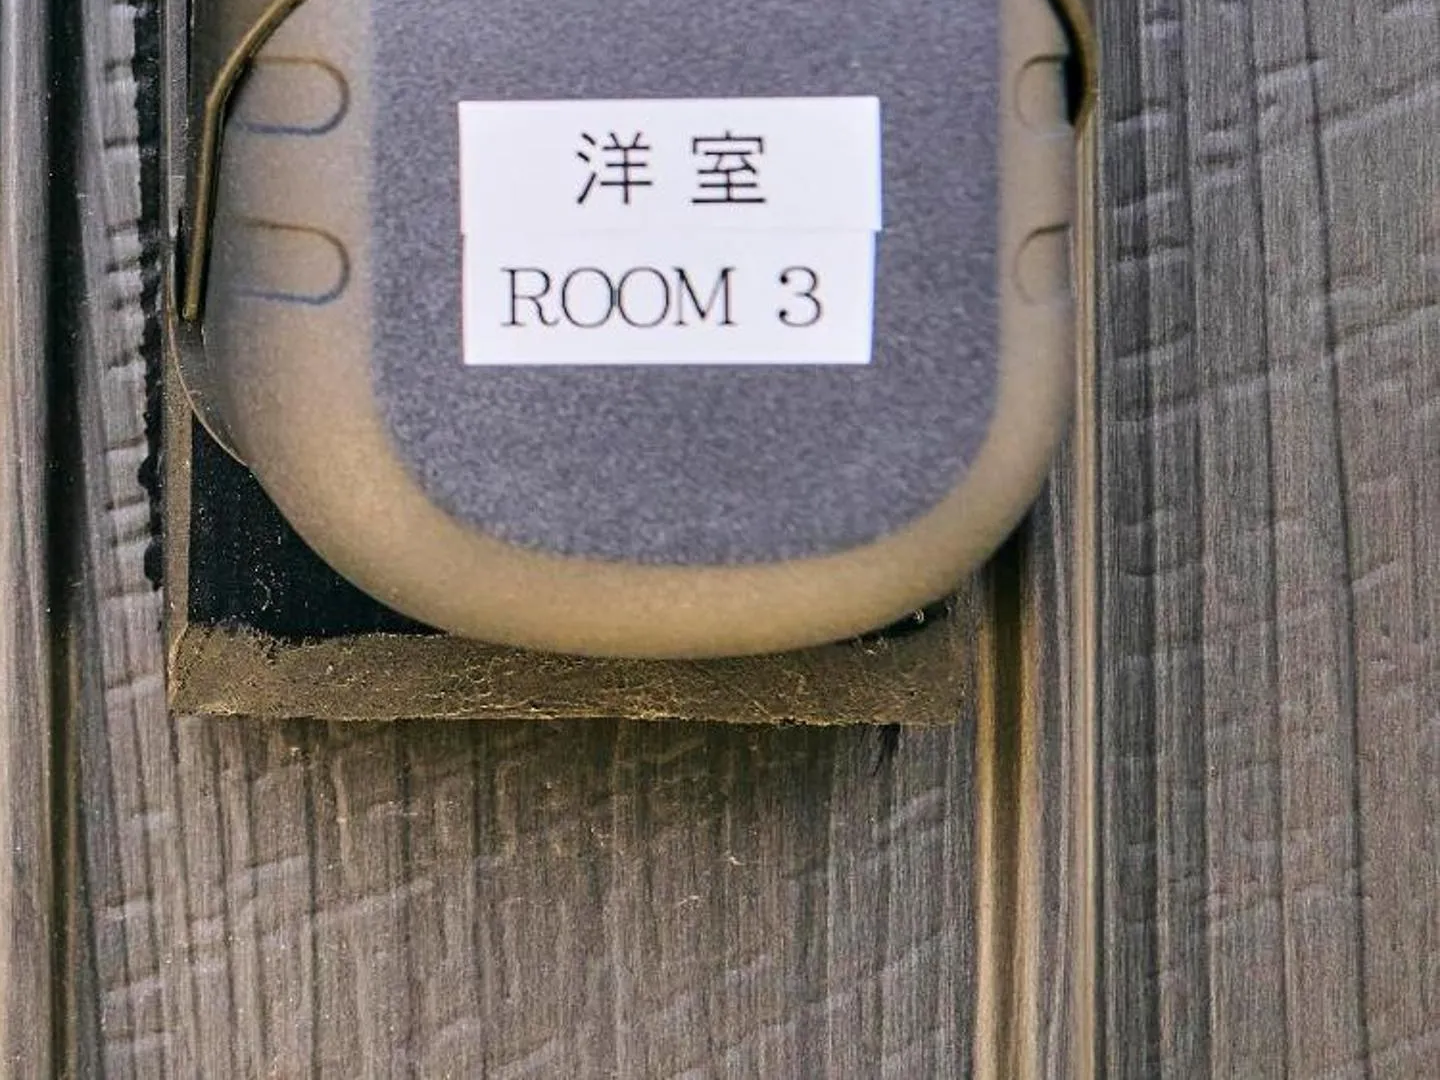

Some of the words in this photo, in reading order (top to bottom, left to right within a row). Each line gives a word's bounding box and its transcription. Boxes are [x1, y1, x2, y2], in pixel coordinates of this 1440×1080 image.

[576, 130, 767, 205] 洋室
[500, 266, 737, 328] ROOM
[778, 266, 822, 327] 3
